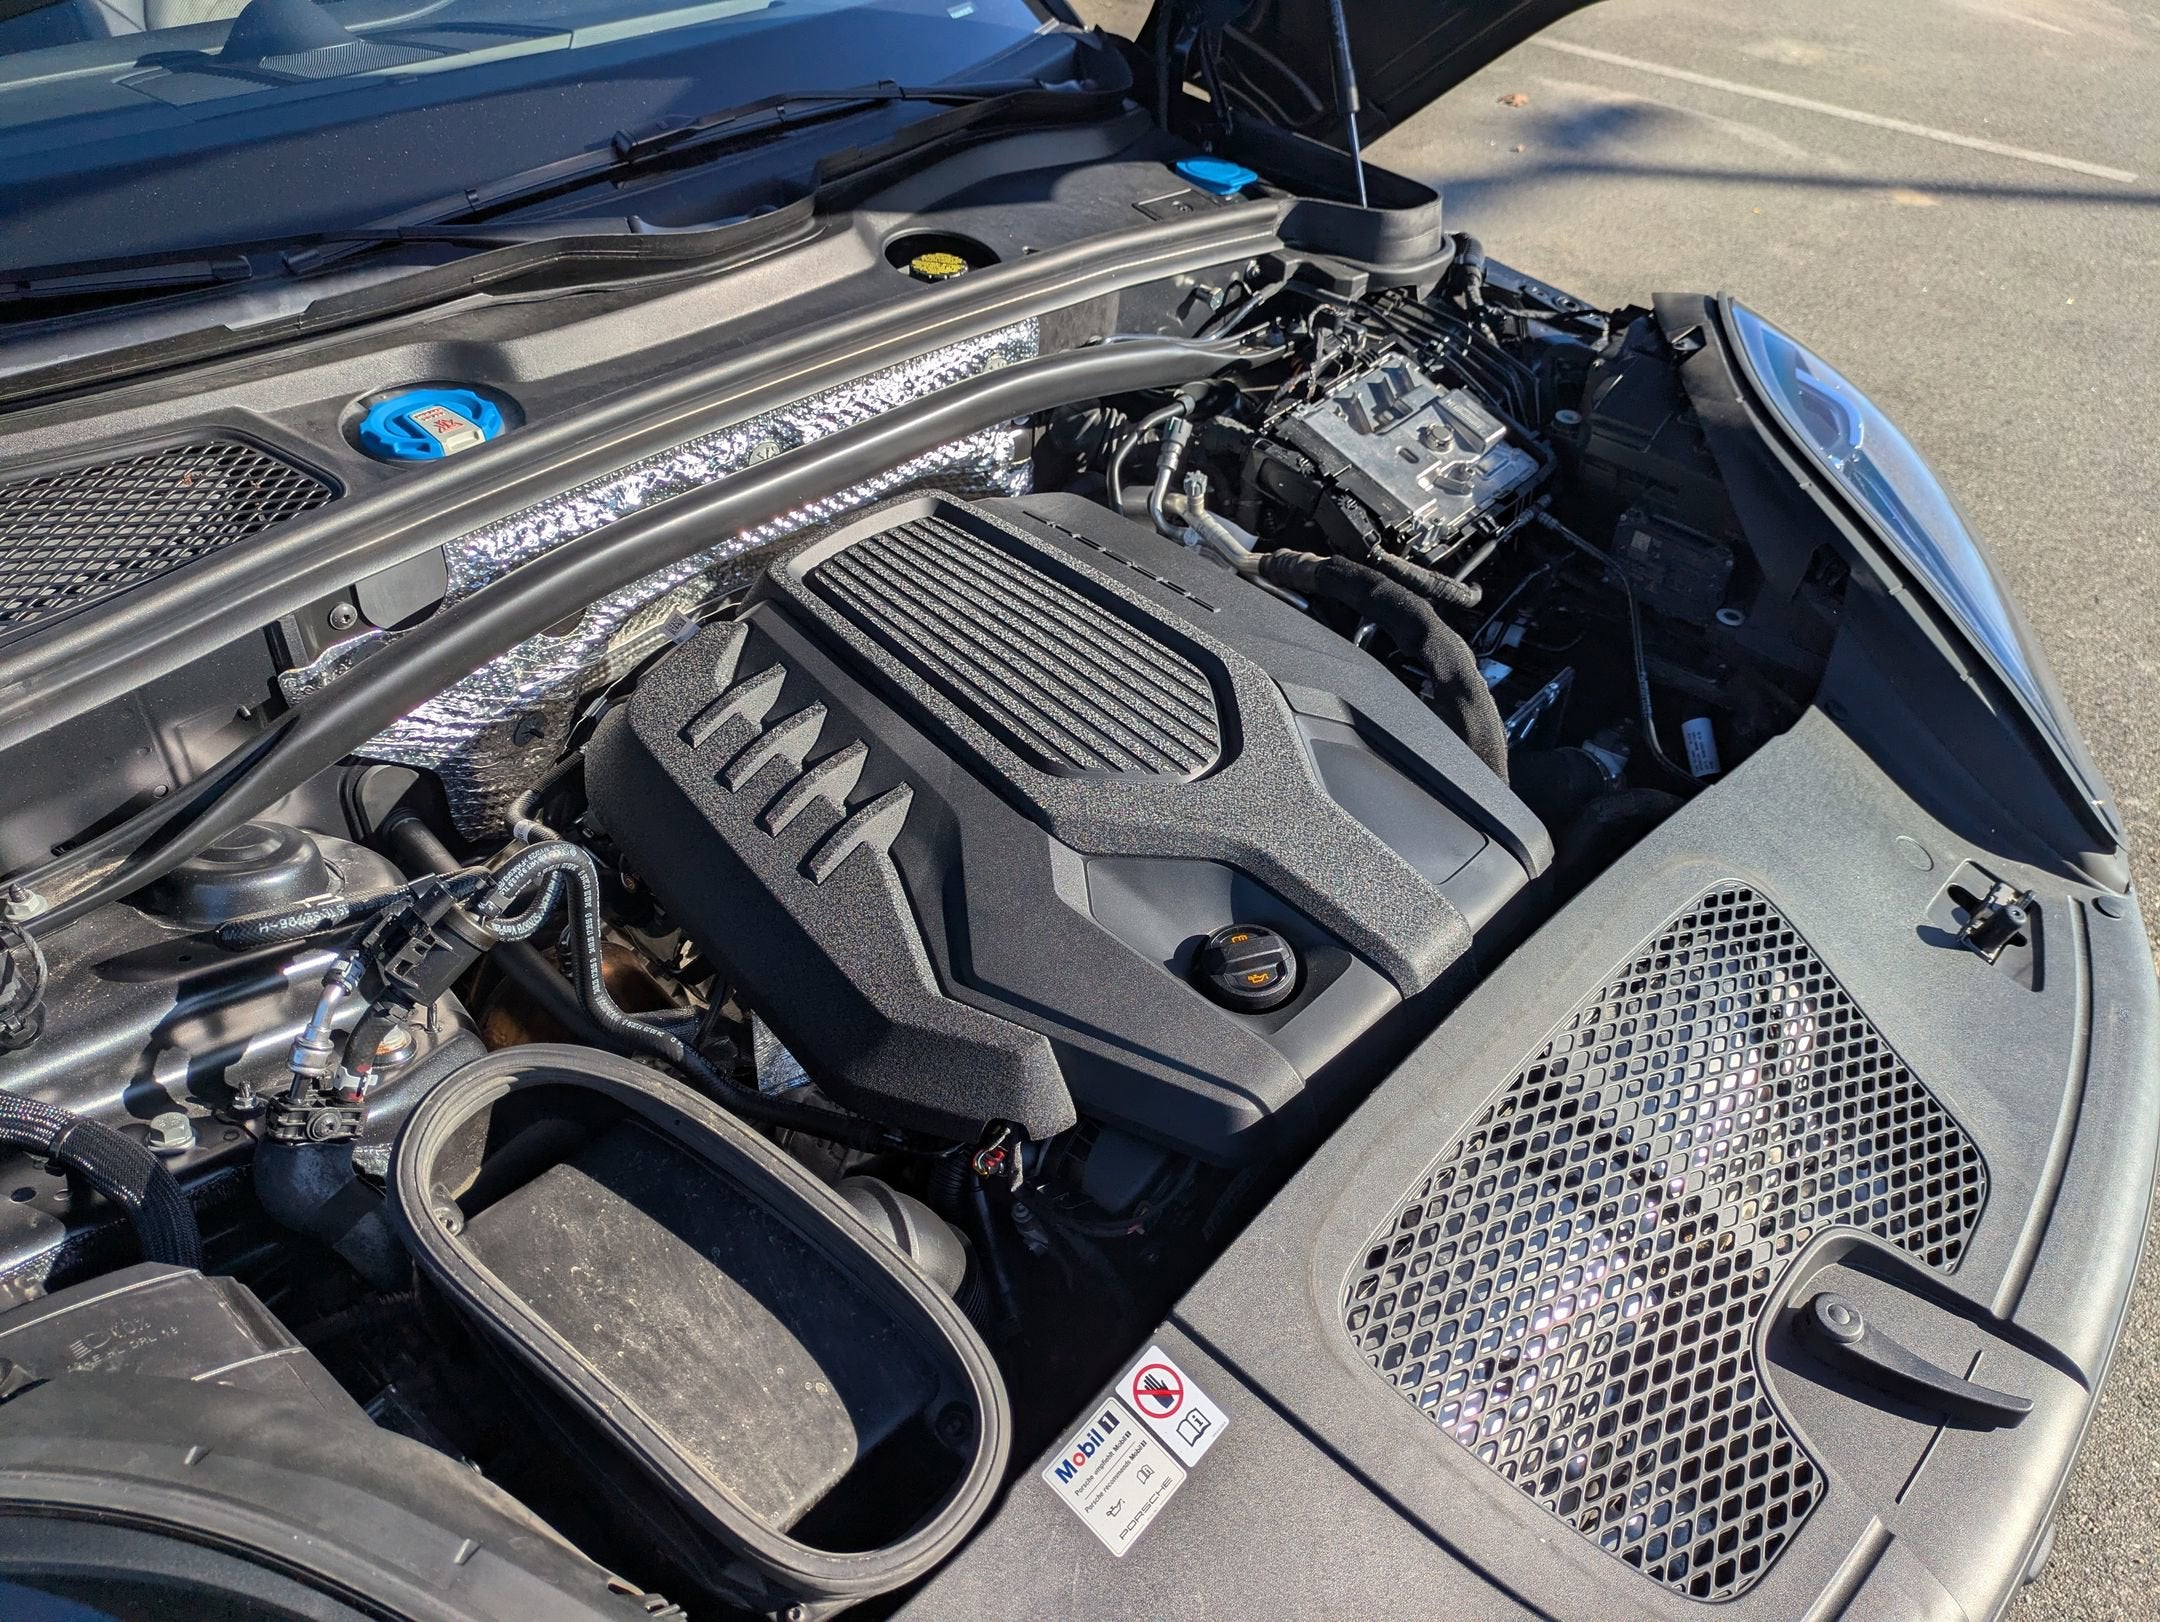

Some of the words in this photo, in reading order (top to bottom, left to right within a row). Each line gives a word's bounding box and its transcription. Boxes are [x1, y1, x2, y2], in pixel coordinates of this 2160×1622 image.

[1054, 1428, 1105, 1485] Mobil
[1074, 1475, 1095, 1496] Porsche
[1094, 1452, 1115, 1476] empfiehlt
[1112, 1436, 1126, 1453] Mobil
[1084, 1490, 1104, 1513] Porsche
[1103, 1460, 1132, 1493] recommends
[1128, 1445, 1143, 1462] Mobil
[1119, 1476, 1173, 1540] PORSCHE
